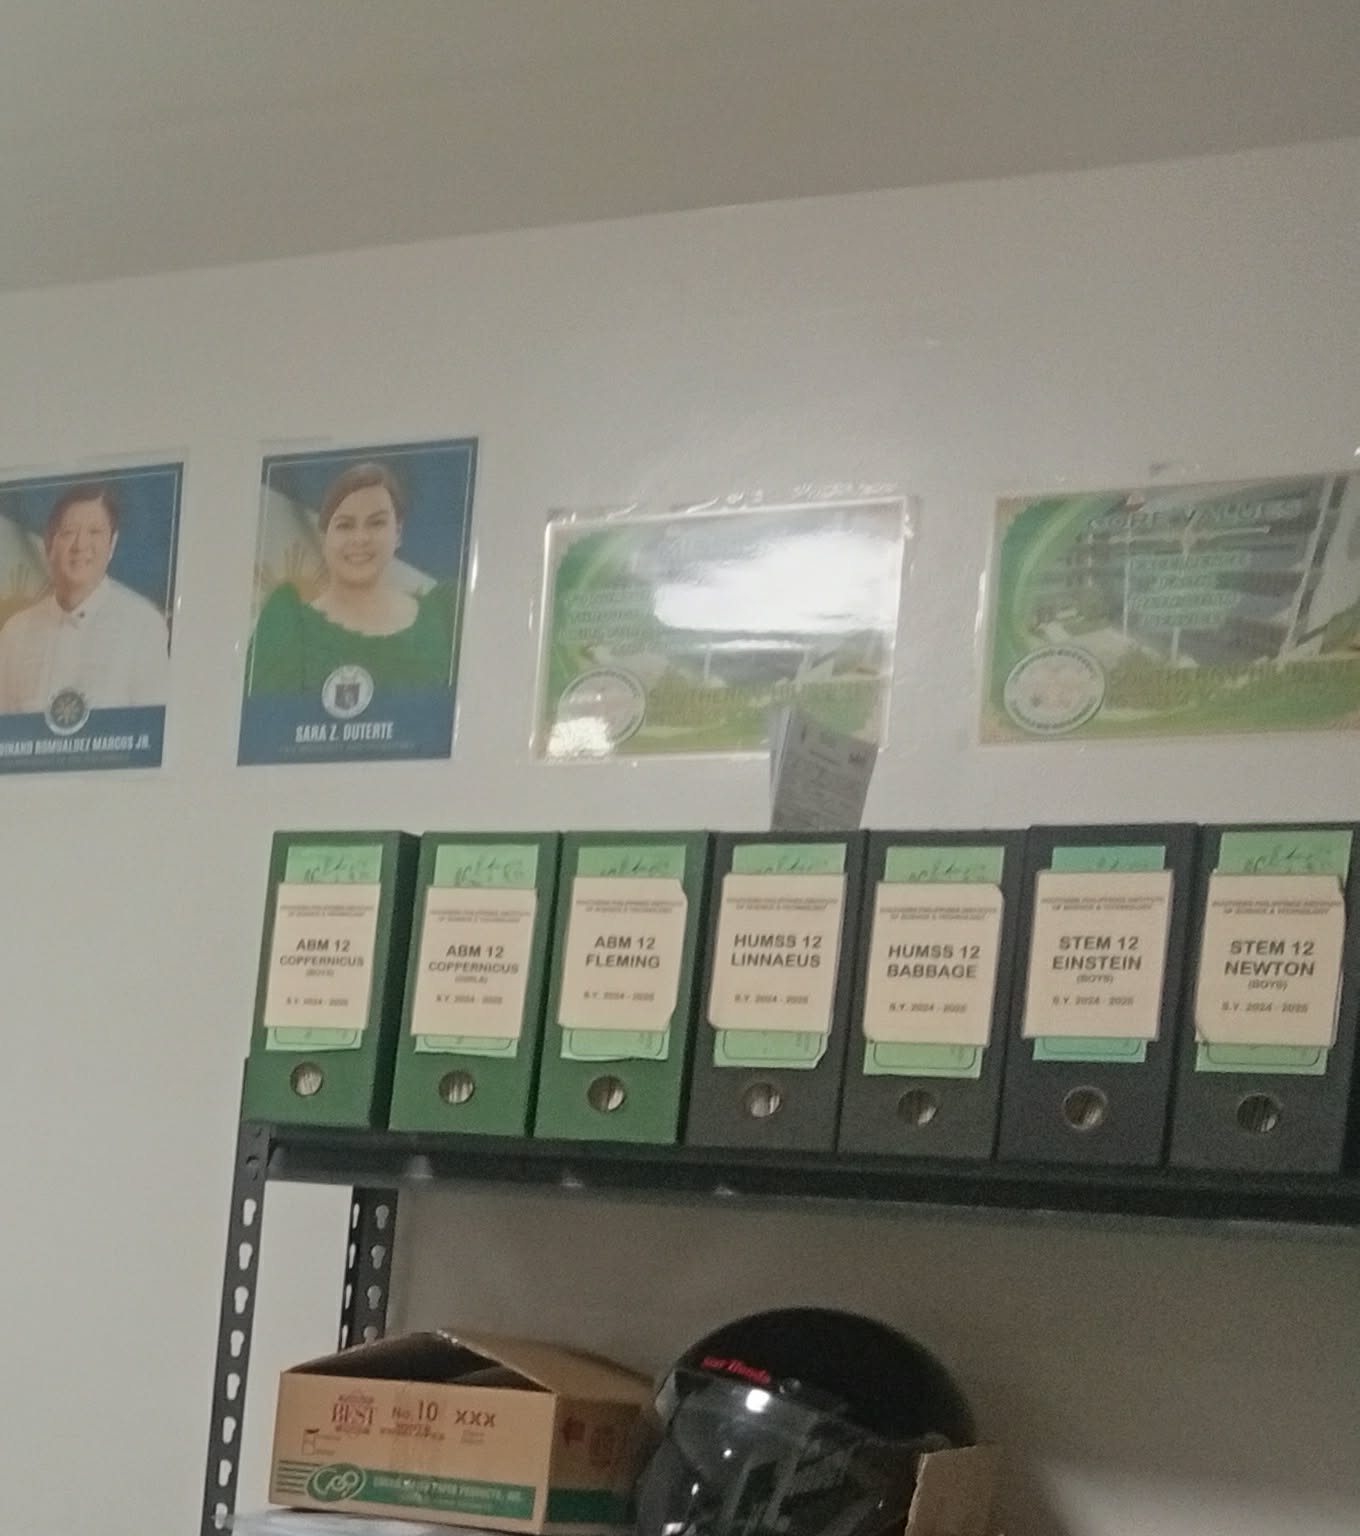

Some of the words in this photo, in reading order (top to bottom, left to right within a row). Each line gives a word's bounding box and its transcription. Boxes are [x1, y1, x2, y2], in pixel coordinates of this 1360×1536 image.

[295, 724, 327, 743] SARA
[343, 722, 394, 741] DUTERTE
[92, 735, 134, 751] MARCOS
[296, 939, 329, 951] ABM
[334, 939, 351, 952] 12
[594, 935, 631, 949] ABM
[636, 936, 656, 950] 12
[734, 933, 796, 948] HUMSS
[802, 934, 823, 949] 12
[1059, 935, 1112, 950] STEM
[1118, 935, 1139, 950] 12
[1230, 939, 1285, 956] STEM
[1292, 940, 1315, 956] 12
[446, 945, 481, 958] ABM
[486, 946, 504, 959] 12
[887, 944, 953, 960] HUMSS
[960, 945, 981, 960] 12
[279, 955, 365, 967] COPPERNICUS
[429, 961, 519, 974] COPPERNICUS
[585, 953, 660, 969] FLEMING
[730, 953, 821, 969] LINNAEUS
[1052, 955, 1142, 971] EINSTEIN
[1224, 960, 1315, 977] NEWTON
[886, 963, 977, 979] BABBAGE
[418, 1399, 439, 1422] 10
